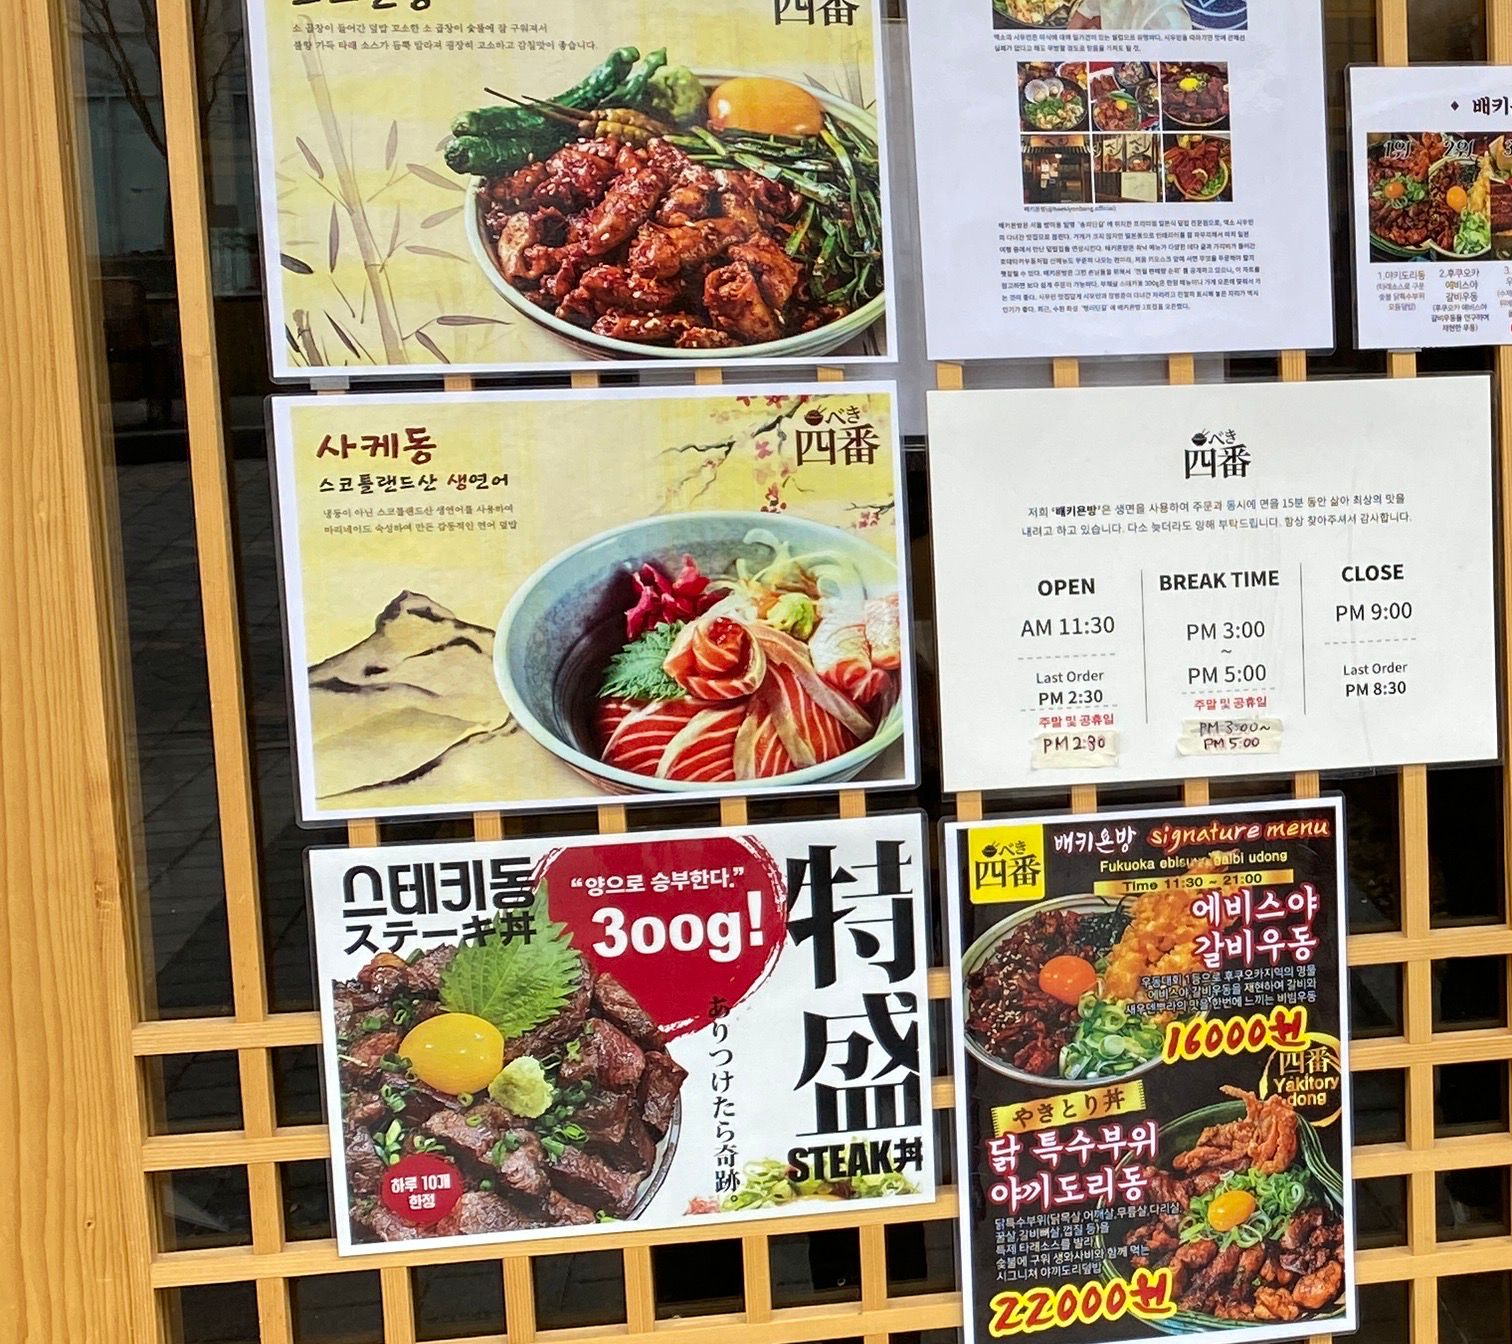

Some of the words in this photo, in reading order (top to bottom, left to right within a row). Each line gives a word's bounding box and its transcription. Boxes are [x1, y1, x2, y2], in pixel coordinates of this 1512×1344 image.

[316, 427, 437, 465] 사케동
[795, 424, 880, 467] 四番
[1183, 443, 1252, 479] 四番
[319, 474, 438, 494] 스코틀랜드산
[447, 473, 509, 491] 생연어
[1028, 507, 1048, 518] 저희
[1149, 502, 1189, 514] 사용하여
[1193, 501, 1222, 512] 주문과
[1282, 497, 1303, 508] 15분
[1057, 525, 1077, 536] 하고
[1080, 524, 1124, 535] 있습니다.
[1128, 523, 1148, 533] 다소
[1360, 511, 1412, 524] 감사합니다.
[1159, 573, 1227, 591] BREAK
[1231, 570, 1280, 588] TIME
[1342, 564, 1404, 582] CLOSE
[1038, 578, 1095, 596] OPEN
[1336, 604, 1365, 622] PM
[1371, 602, 1412, 620] 9:00
[1021, 619, 1051, 637] AM
[1059, 616, 1115, 635] 11:30
[1187, 623, 1216, 640] PM
[1223, 621, 1265, 639] 3:00
[1036, 672, 1063, 684] Last
[1066, 670, 1104, 682] Order
[1188, 667, 1218, 684] PM
[1224, 664, 1266, 682] 5:00
[1343, 665, 1369, 676] Last
[1372, 662, 1408, 674] Order
[1039, 692, 1063, 706] PM
[1068, 689, 1103, 703] 2:30
[1346, 683, 1368, 697] PM
[1373, 681, 1406, 695] 8:30
[1194, 698, 1217, 710] 주말
[1220, 698, 1231, 709] 및
[1233, 696, 1267, 709] 공휴일
[1039, 716, 1063, 728] 주말
[1065, 716, 1077, 727] 및
[1079, 713, 1114, 727] 공휴일
[1199, 721, 1220, 737] PM
[1043, 736, 1069, 753] PM
[1204, 738, 1224, 749] PM
[1229, 737, 1260, 749] 5:00
[1054, 825, 1137, 854] 배키욘방
[1151, 823, 1259, 853] signature
[1267, 820, 1329, 837] menu
[975, 854, 1041, 889] 四番
[1100, 859, 1155, 872] Fukuoka
[1248, 851, 1287, 864] udong
[343, 857, 535, 918] 스테키동
[1123, 881, 1157, 892] Time
[1165, 877, 1203, 889] 11:30
[1224, 874, 1262, 885] 21:00
[1193, 887, 1319, 926] 에비스야
[344, 911, 537, 955] ステーキ丼
[1195, 931, 1316, 966] 갈비우동
[785, 840, 922, 1137] 特盛
[1165, 1009, 1307, 1061] 16000원
[1273, 1073, 1339, 1093] Yakitory
[1012, 1088, 1126, 1128] やきとり丼
[1287, 1092, 1326, 1107] dong
[988, 1139, 1021, 1172] 닭
[1032, 1122, 1160, 1163] 특수부위
[391, 1176, 420, 1194] 하루
[423, 1175, 452, 1192] 10개
[989, 1169, 1148, 1212] 야끼도리동
[408, 1192, 436, 1210] 한정
[991, 1272, 1176, 1334] 22000원
